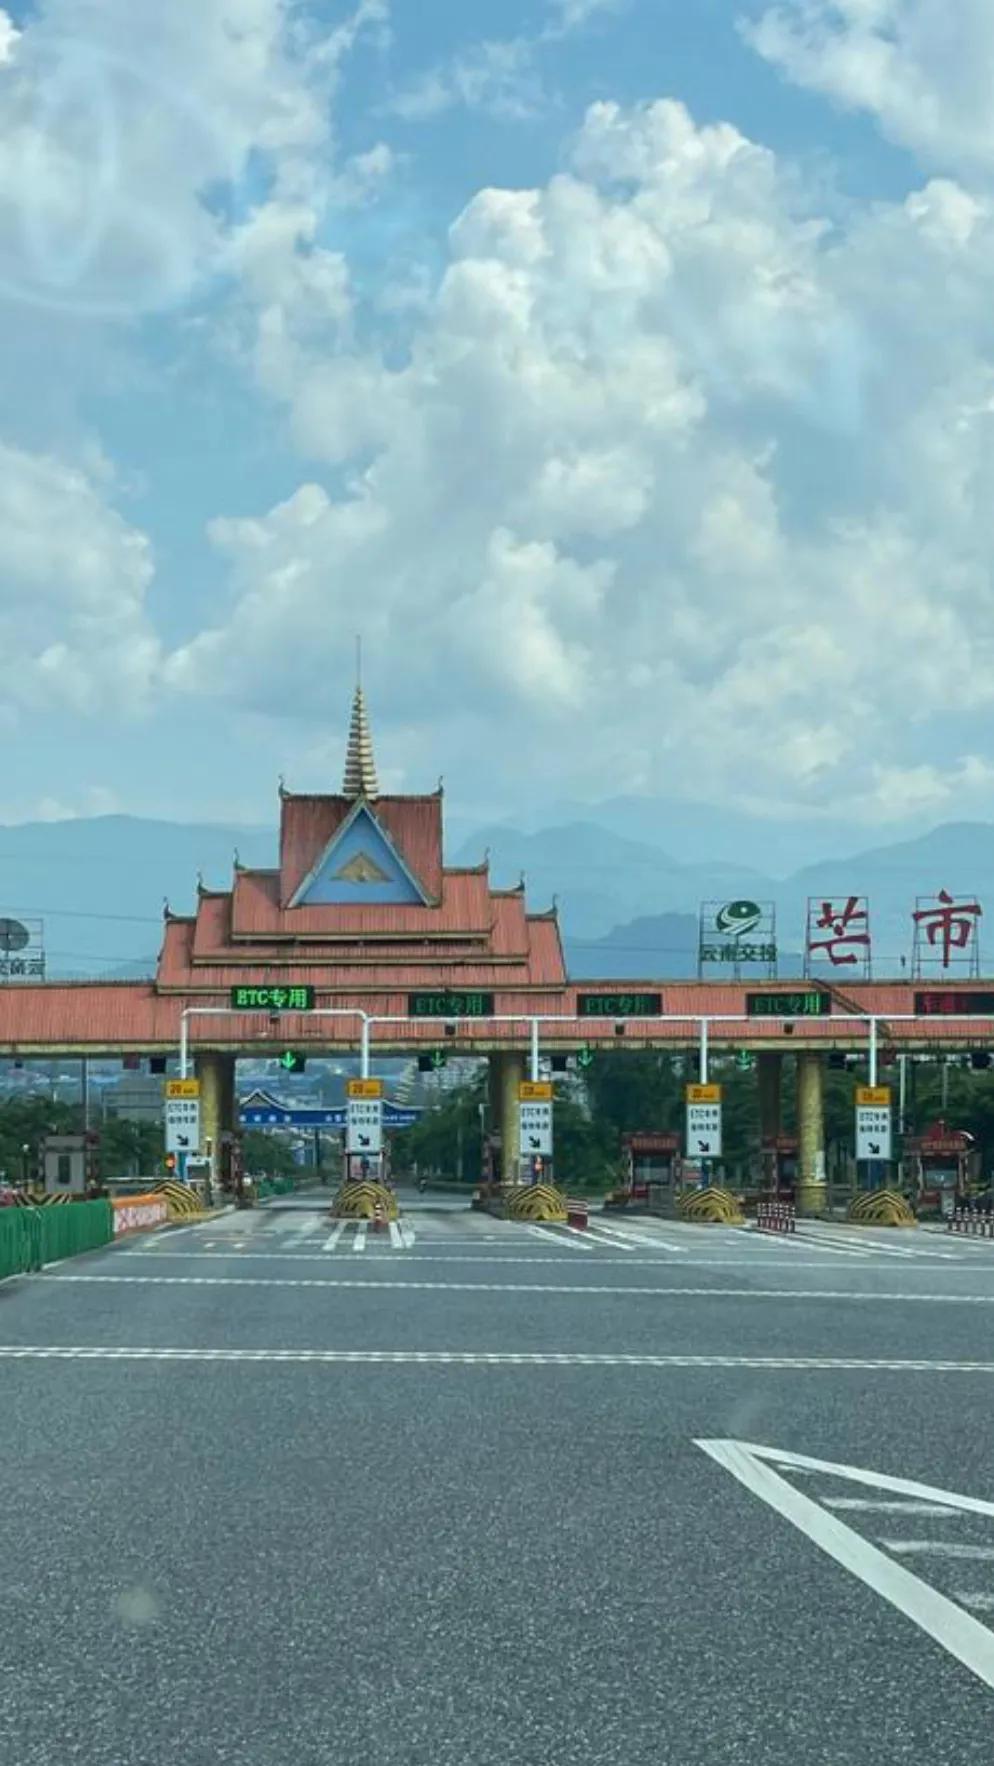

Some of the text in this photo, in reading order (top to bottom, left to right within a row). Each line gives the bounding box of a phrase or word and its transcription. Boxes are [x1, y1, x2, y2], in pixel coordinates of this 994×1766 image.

[700, 943, 777, 962] 云南交投
[809, 888, 982, 969] 芒市
